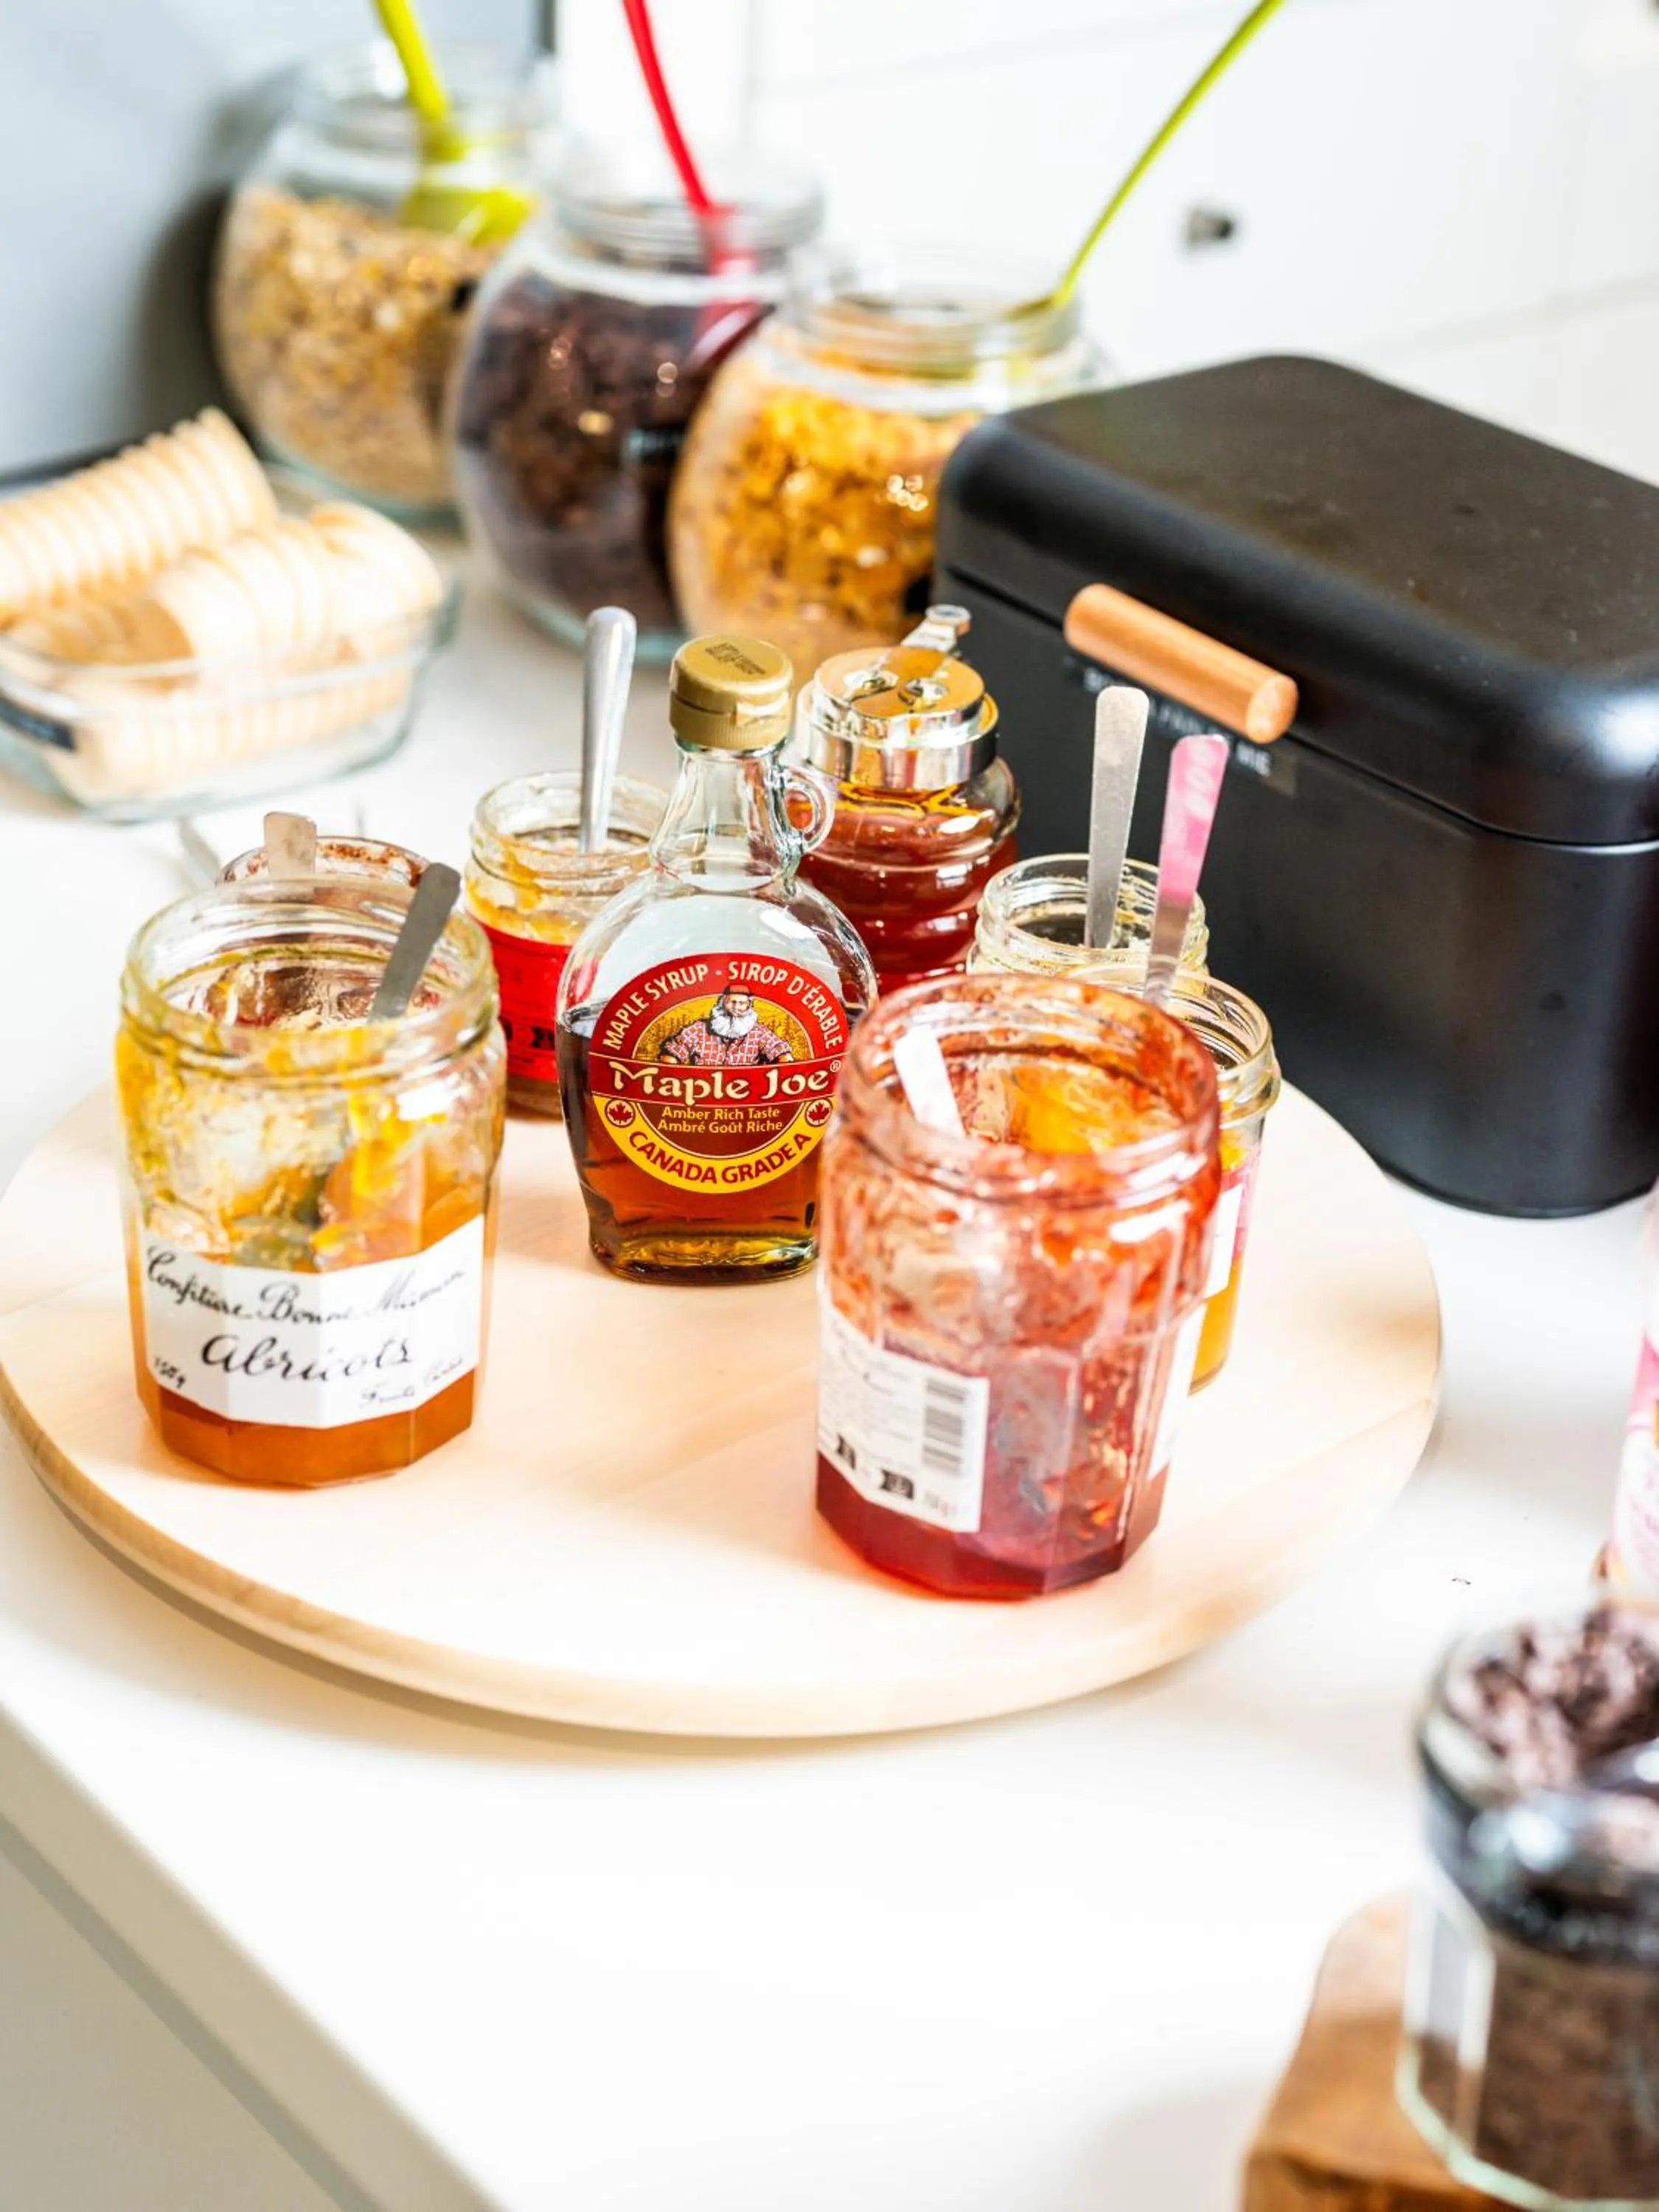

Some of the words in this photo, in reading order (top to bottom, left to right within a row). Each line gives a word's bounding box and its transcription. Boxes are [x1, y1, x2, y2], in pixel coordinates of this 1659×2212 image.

[602, 992, 649, 1050] MAPLE
[644, 964, 709, 1001] SYRUP
[728, 961, 788, 985] SIROP
[787, 975, 843, 1049] D'ÉRABLE
[608, 1061, 750, 1106] Maple
[761, 1068, 829, 1099] Joe
[658, 1119, 706, 1133] Ambré
[709, 1121, 742, 1134] Goût
[746, 1121, 782, 1133] Riche
[661, 1107, 711, 1119] Amber
[714, 1108, 744, 1120] Rich
[748, 1107, 780, 1119] Taste
[629, 1131, 717, 1184] CANADA
[721, 1143, 797, 1184] GRADE
[793, 1133, 812, 1151] A
